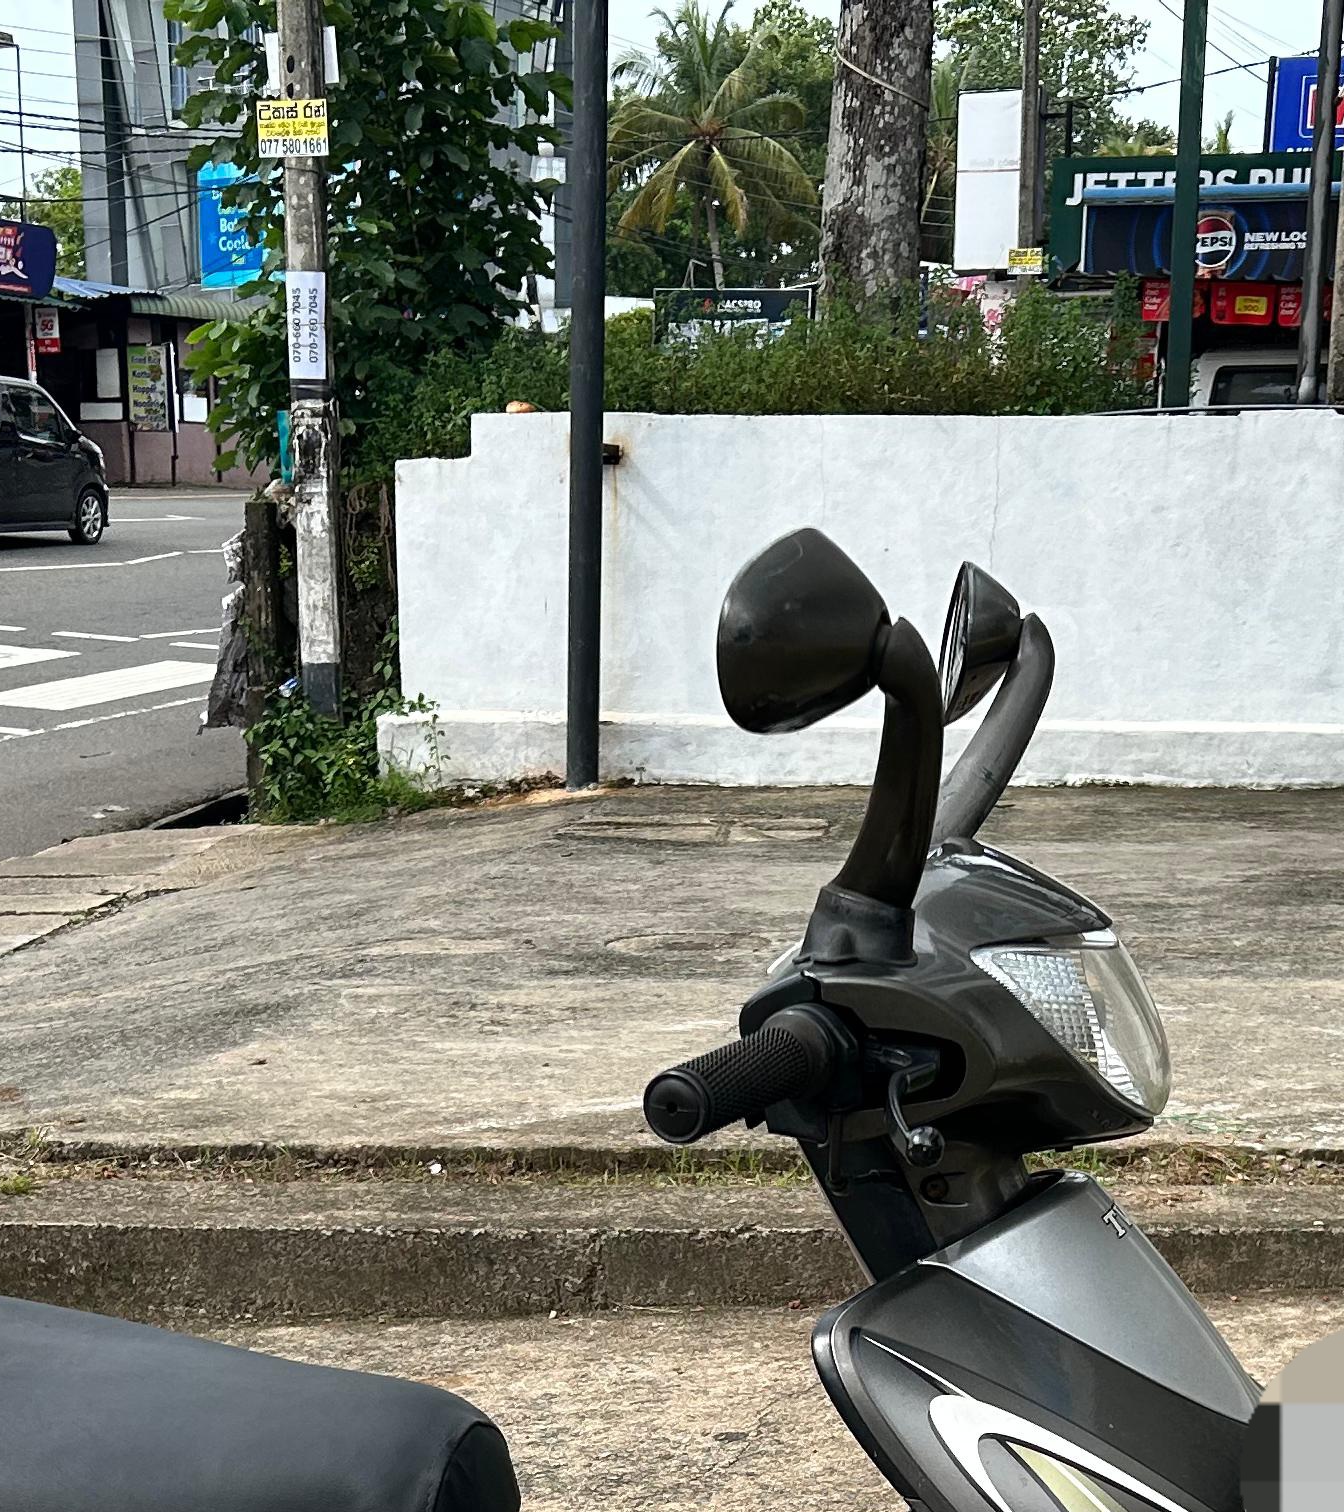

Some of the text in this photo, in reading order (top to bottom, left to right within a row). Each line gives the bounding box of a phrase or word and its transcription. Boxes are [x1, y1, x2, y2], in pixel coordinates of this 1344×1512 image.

[260, 138, 279, 155] 077
[1199, 236, 1234, 248] EPSI
[1244, 231, 1280, 242] NEW
[308, 287, 319, 315] 7045
